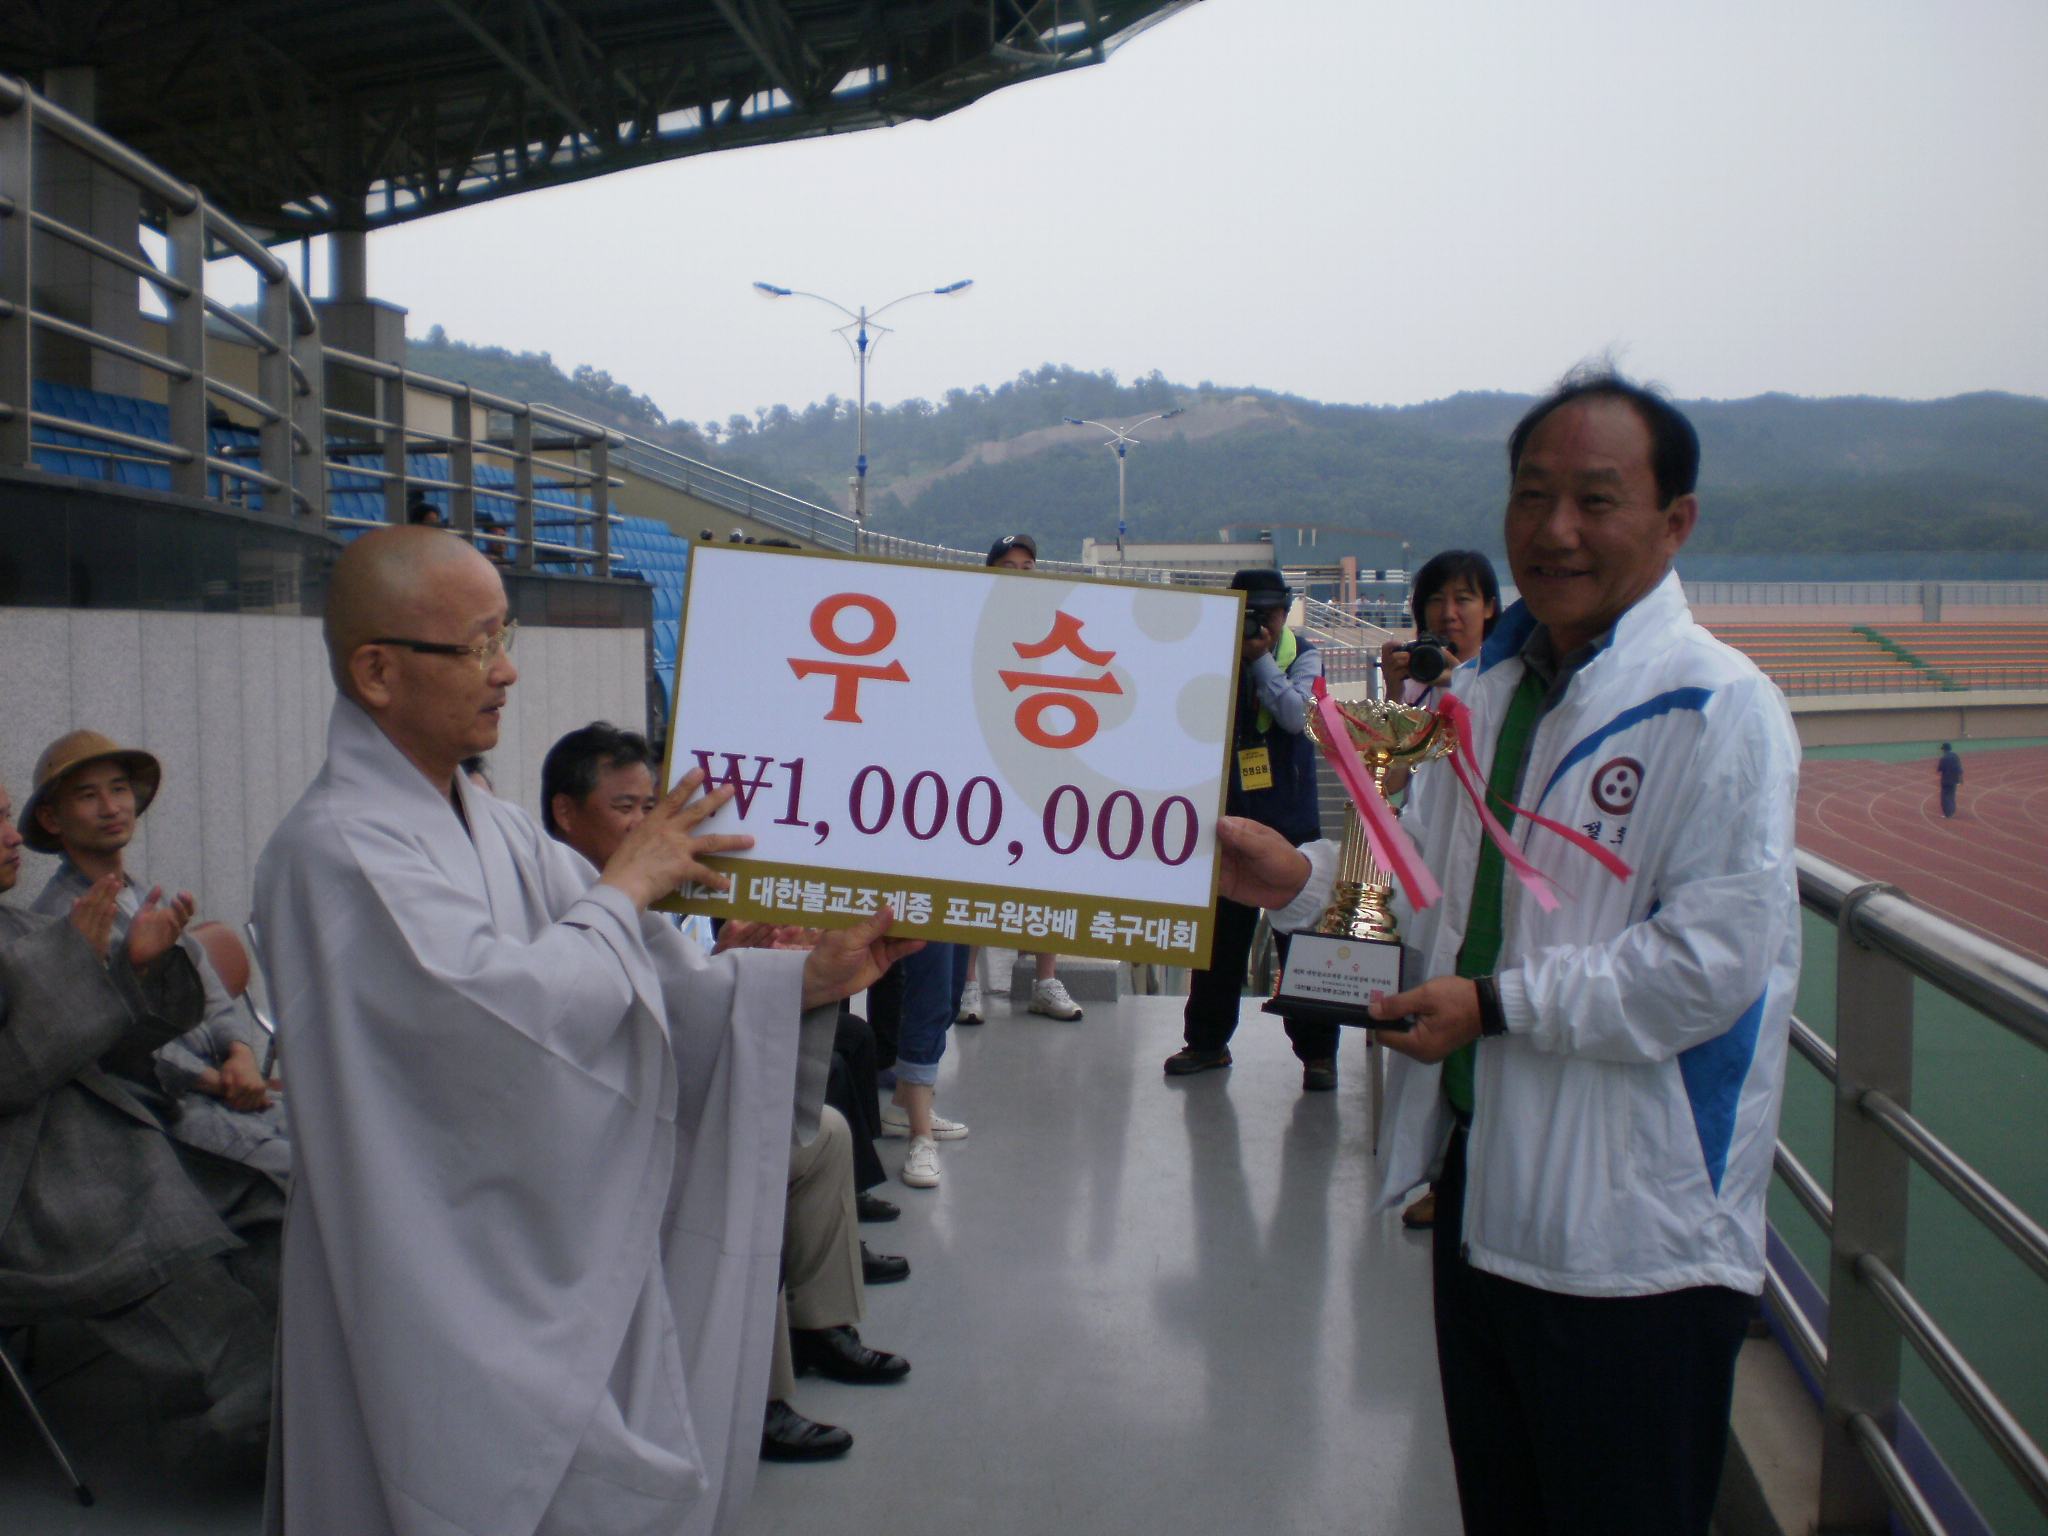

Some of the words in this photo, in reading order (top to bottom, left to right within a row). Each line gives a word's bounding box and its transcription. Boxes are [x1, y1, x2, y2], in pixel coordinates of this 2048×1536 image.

[749, 876, 933, 924] 대한불교조계종
[943, 898, 1078, 940] 포교원장배
[1089, 911, 1198, 953] 축구대회
